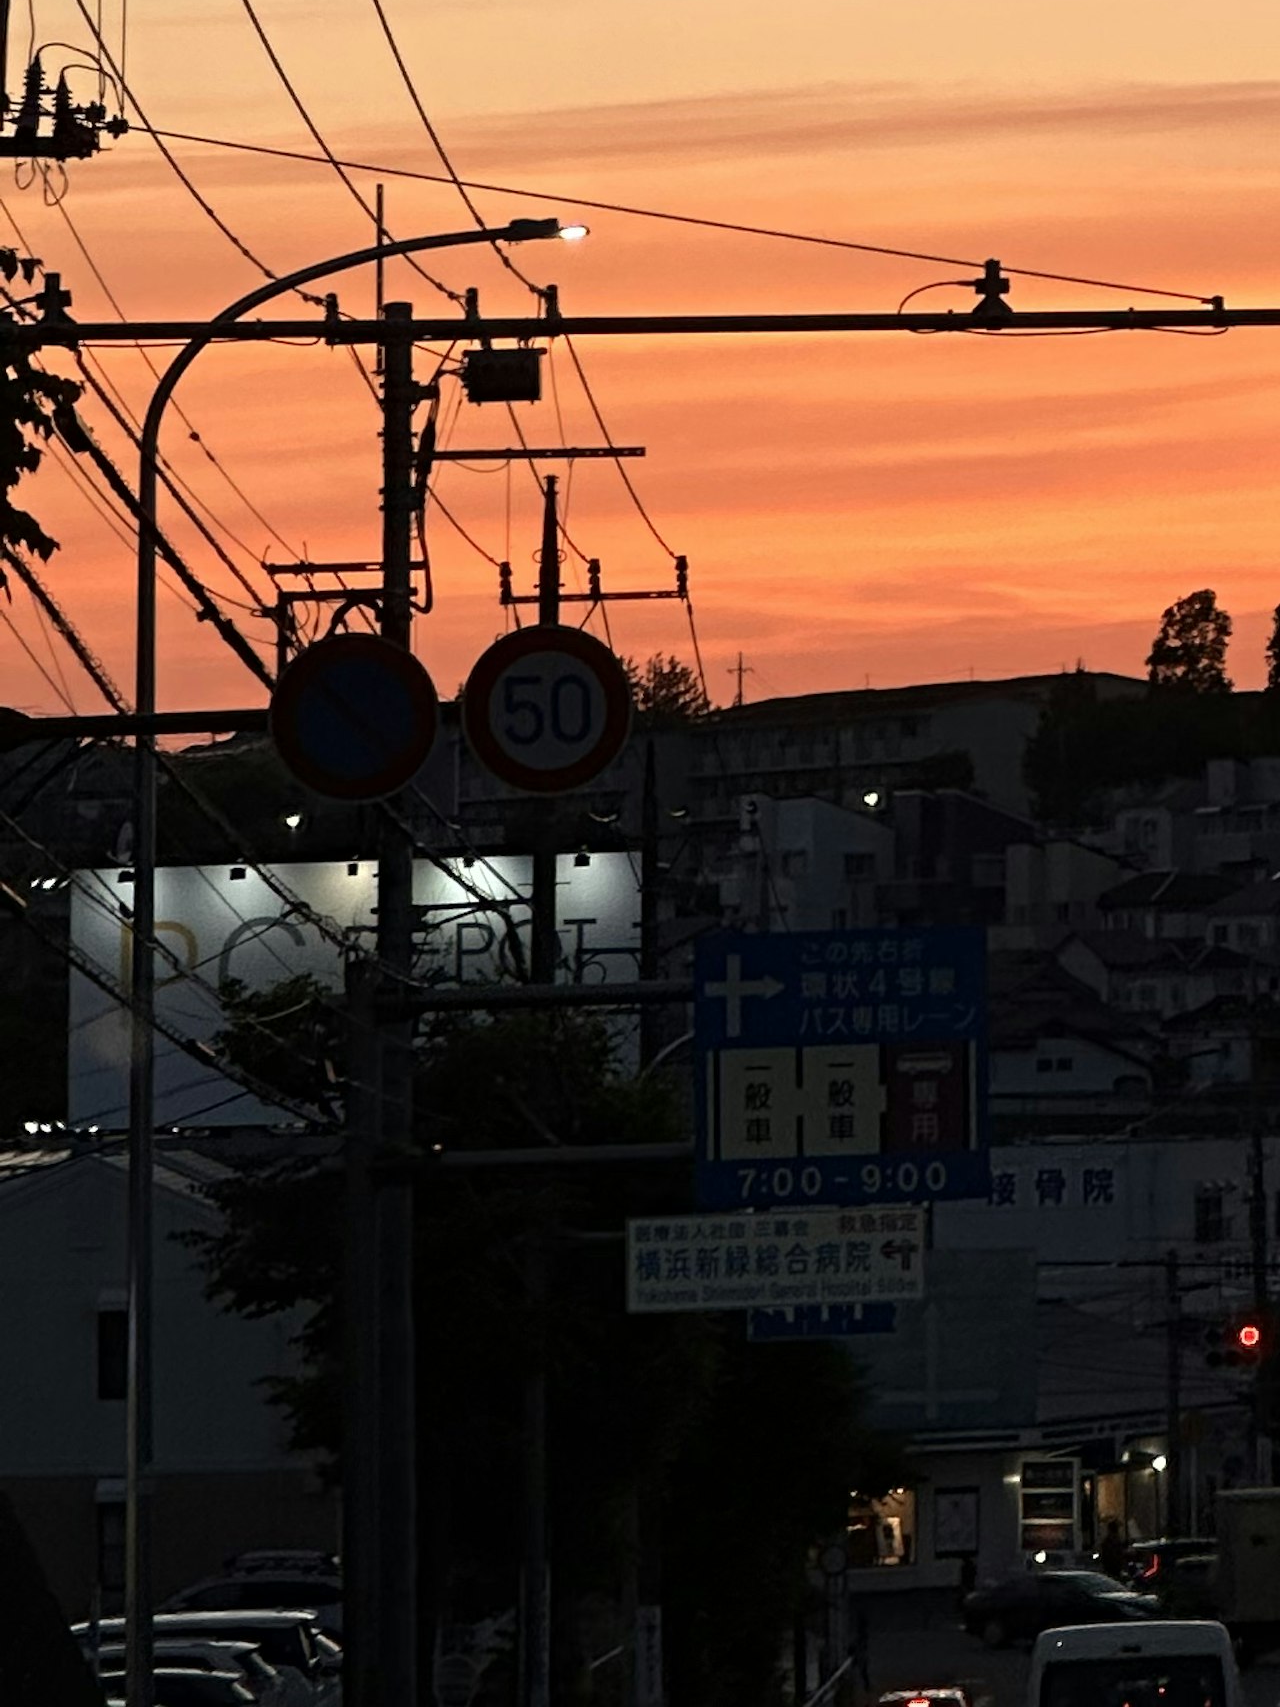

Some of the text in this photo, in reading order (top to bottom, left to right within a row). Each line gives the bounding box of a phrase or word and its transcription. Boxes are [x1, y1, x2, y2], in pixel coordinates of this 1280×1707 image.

[502, 673, 593, 745] 50
[801, 937, 924, 964] この先右折
[800, 1002, 976, 1035] バス専用レーン
[744, 1065, 772, 1144] 一般車
[827, 1062, 855, 1139] 一般車
[837, 1213, 918, 1235] 救急指定
[635, 1240, 872, 1281] 横浜新緑総合病院
